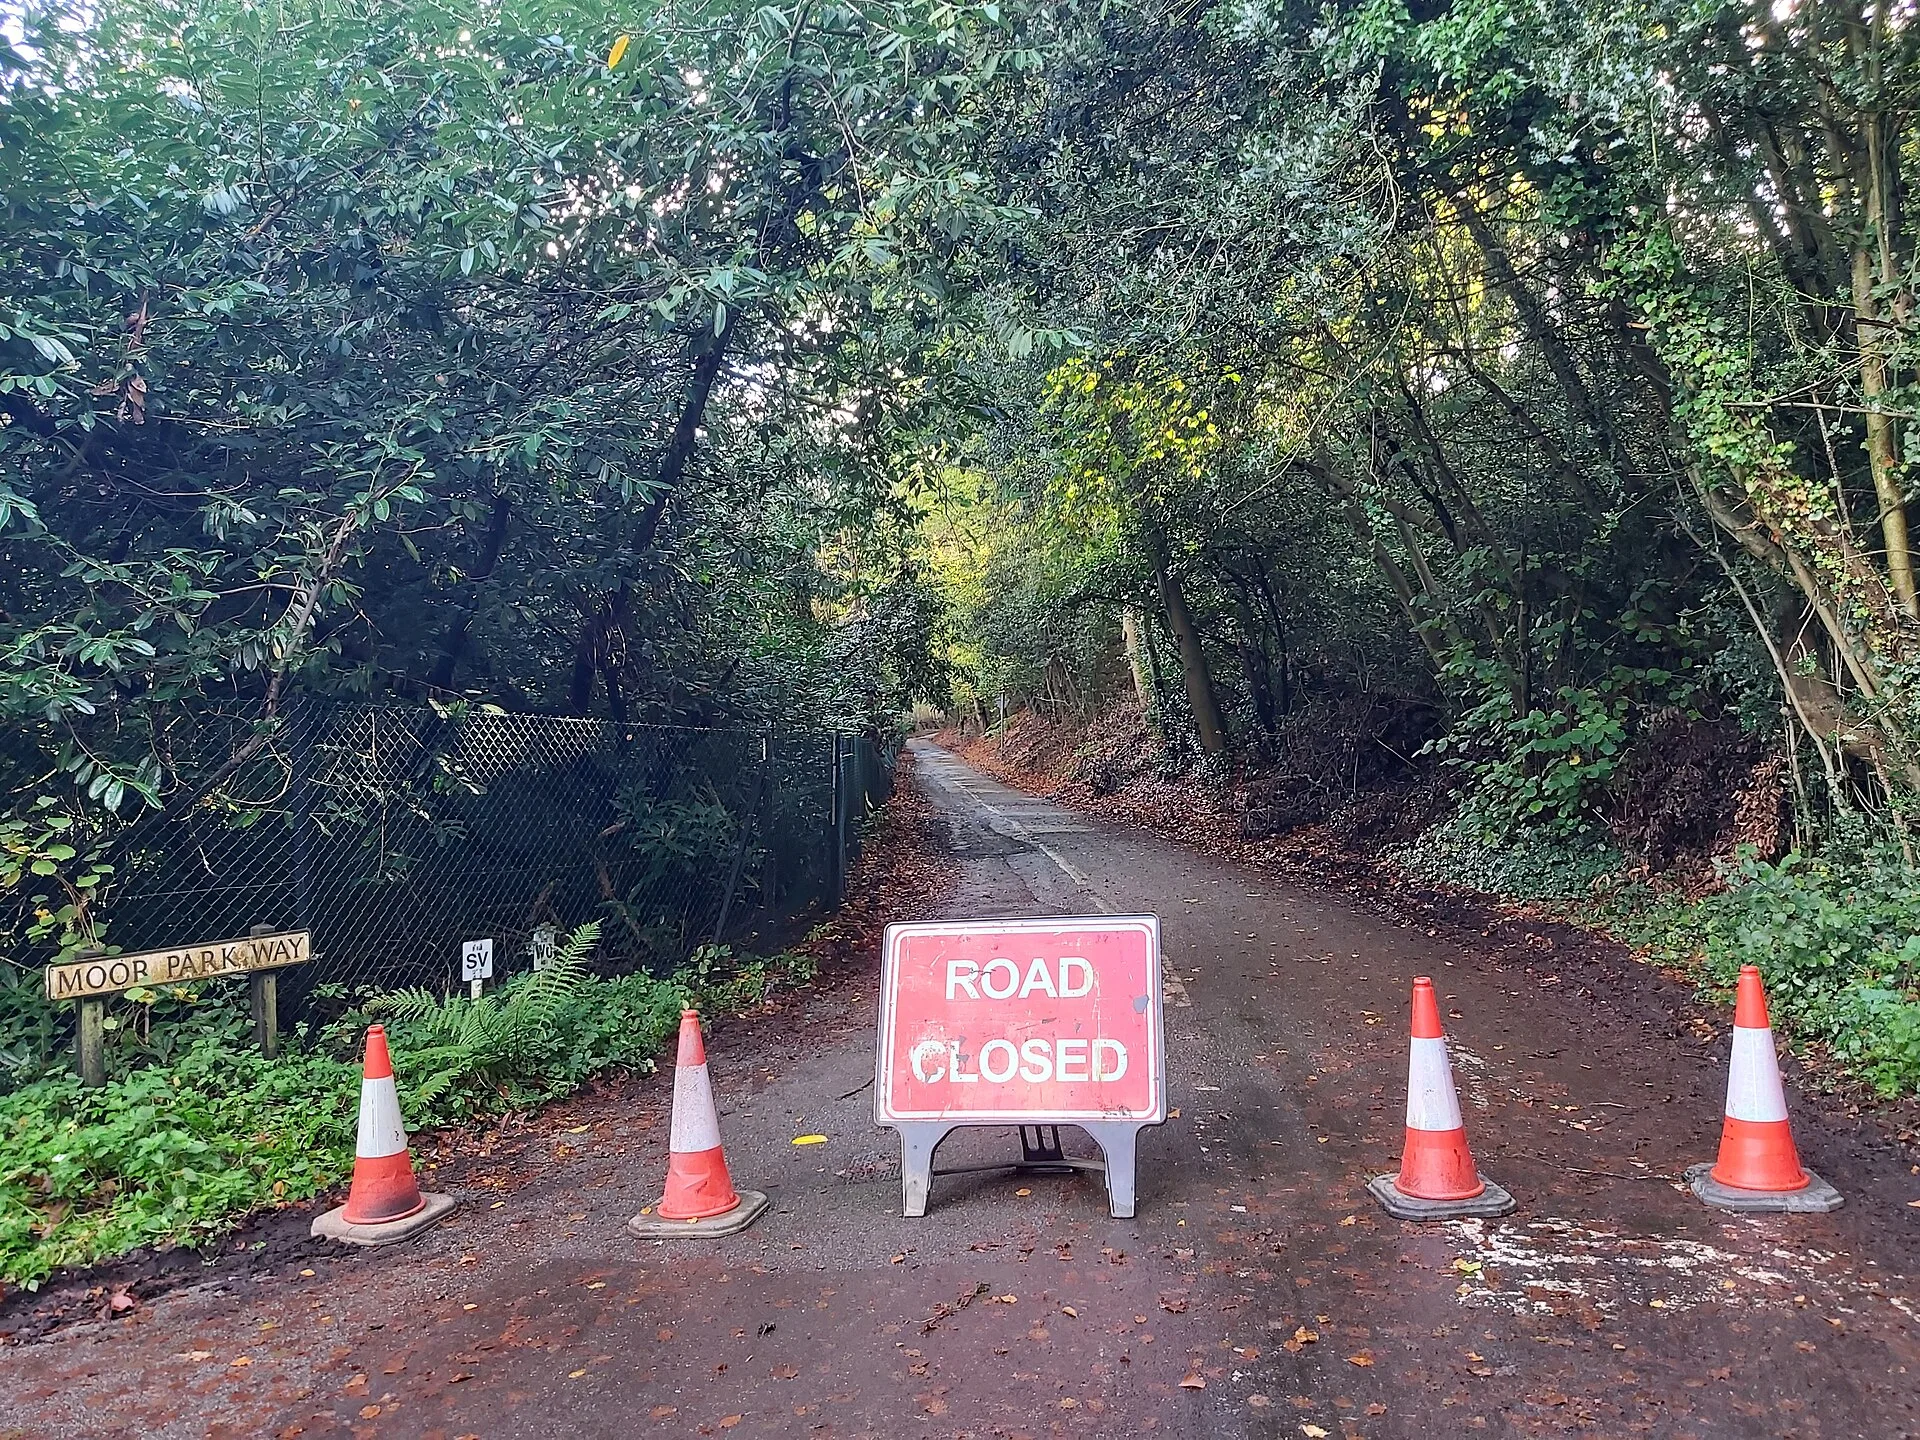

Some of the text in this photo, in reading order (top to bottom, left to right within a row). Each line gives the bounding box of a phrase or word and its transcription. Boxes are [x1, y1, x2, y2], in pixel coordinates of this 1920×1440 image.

[58, 936, 304, 994] MOOR PARK WAY
[466, 951, 489, 970] SV
[945, 956, 1094, 1001] ROAD
[911, 1038, 1129, 1084] CLOSED
